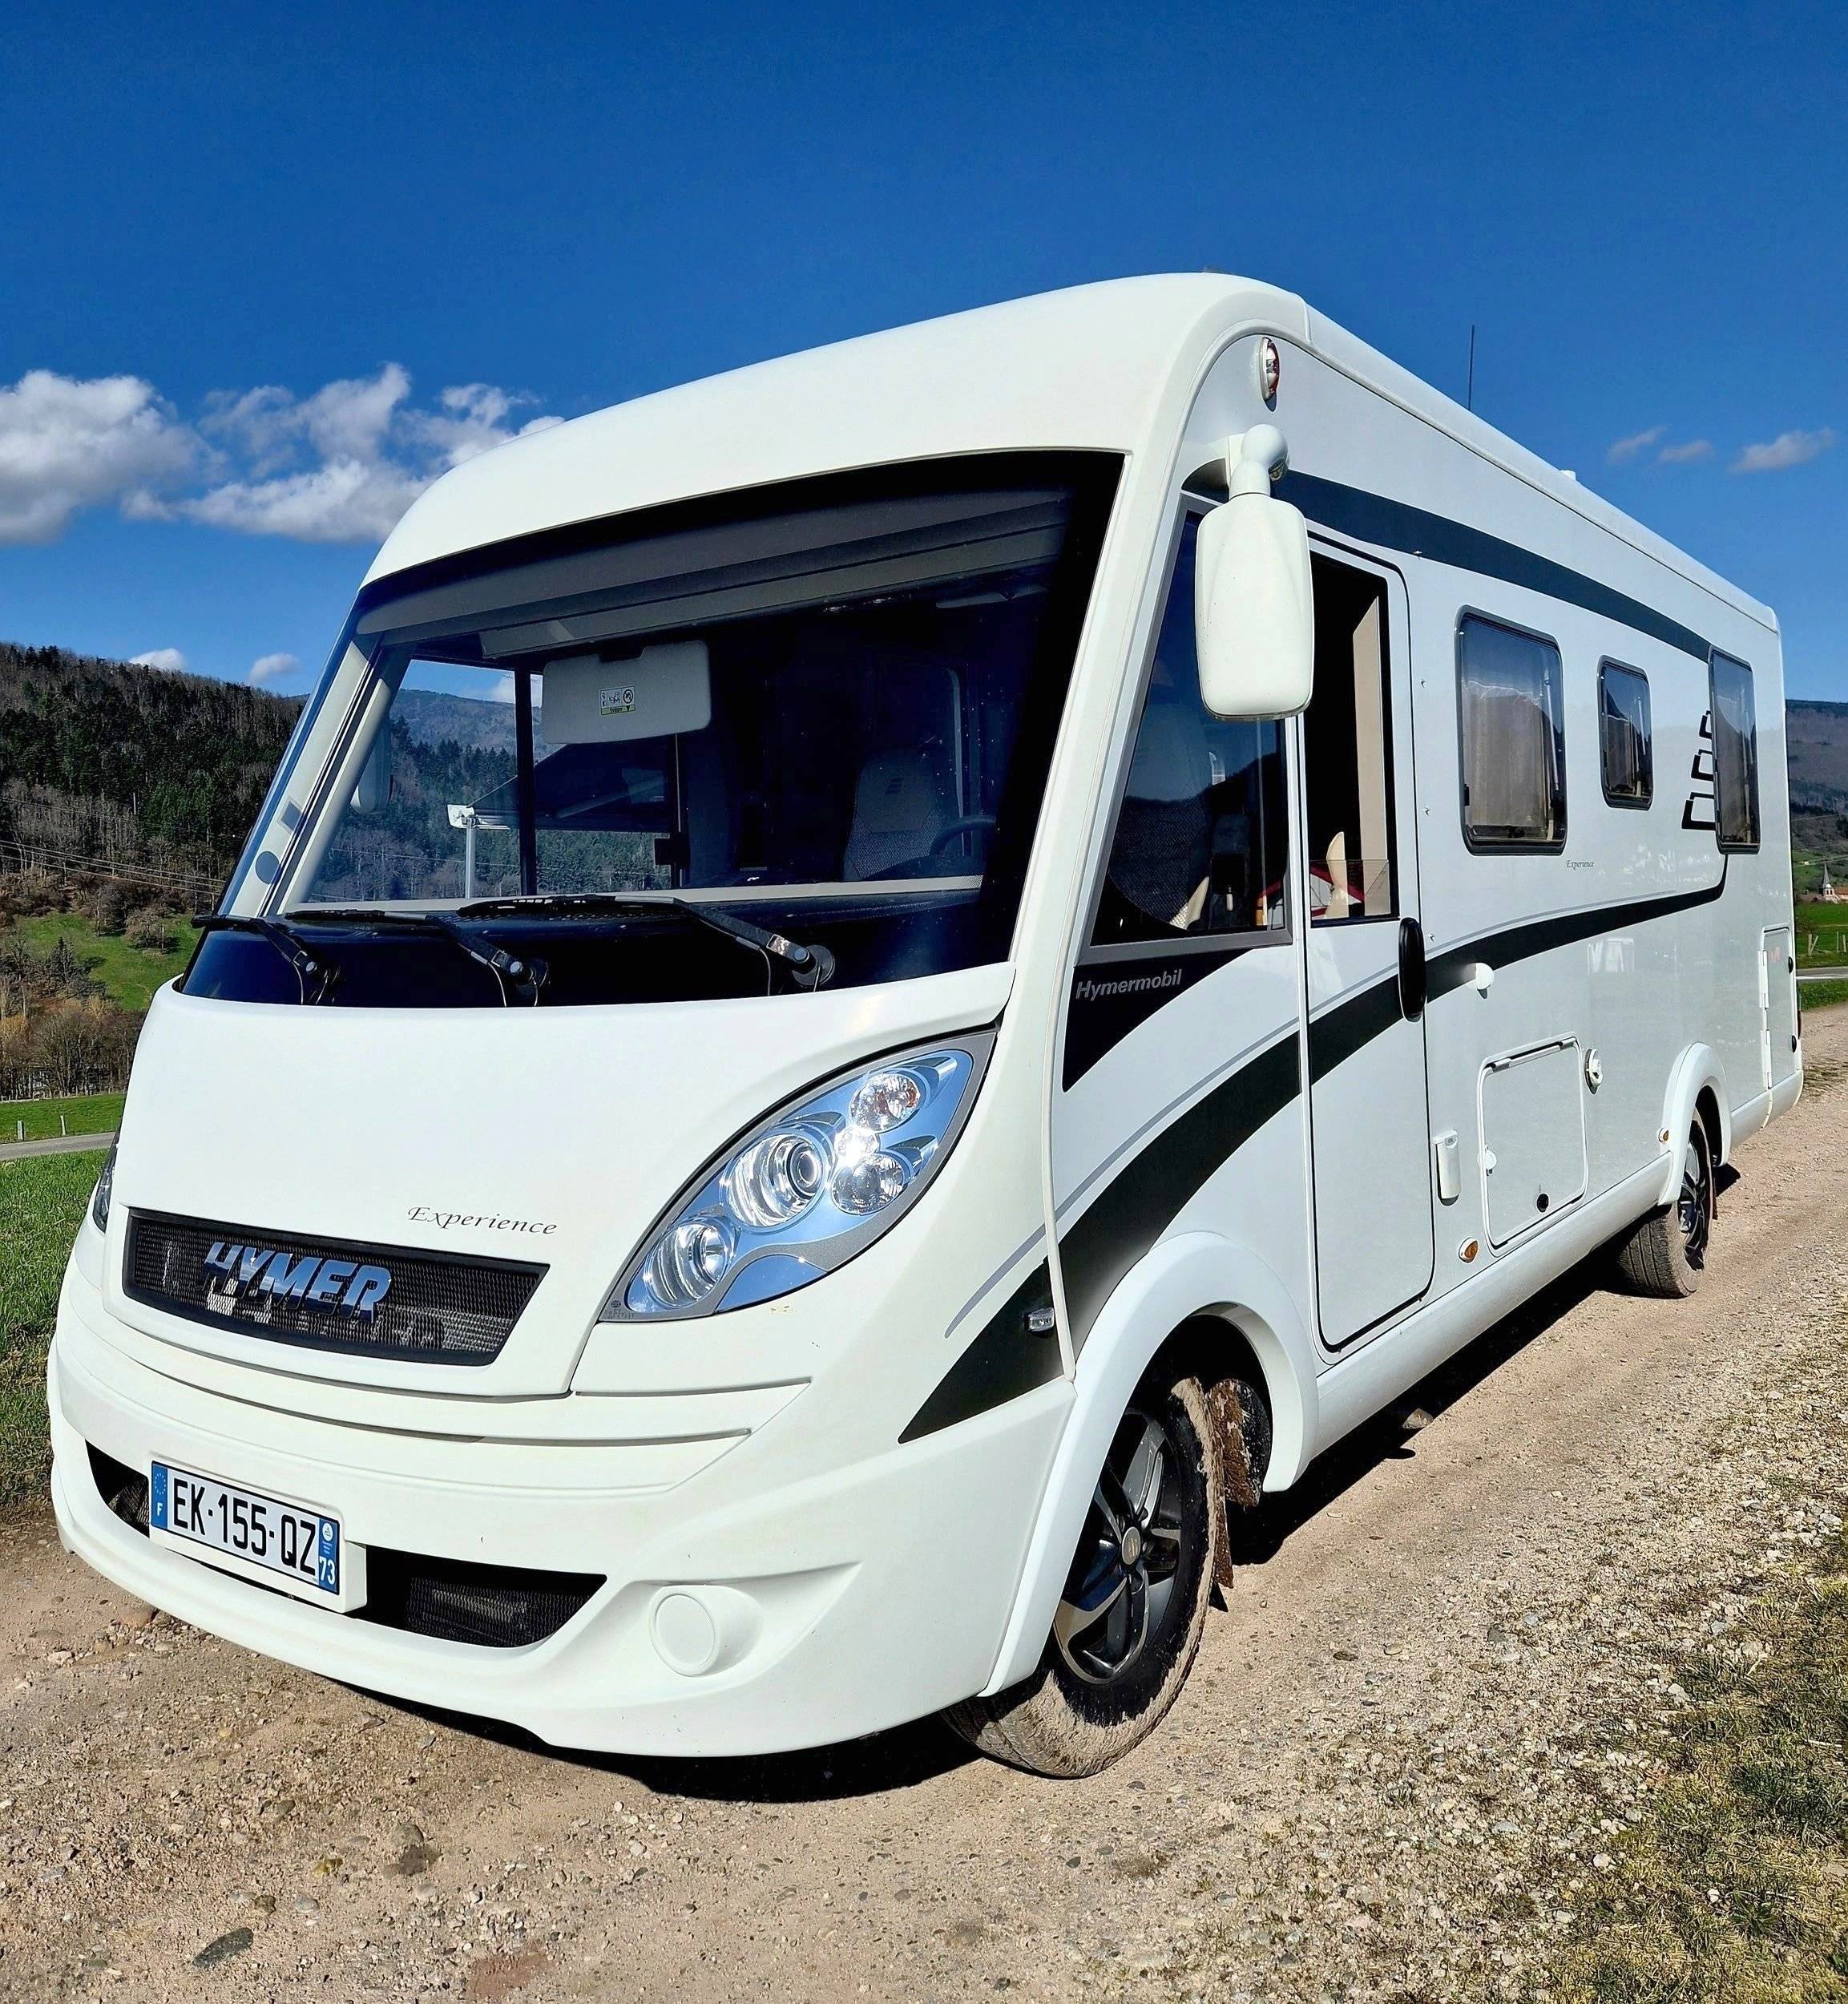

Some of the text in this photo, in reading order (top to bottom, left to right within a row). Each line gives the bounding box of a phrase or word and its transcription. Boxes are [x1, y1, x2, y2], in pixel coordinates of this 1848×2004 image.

[1075, 968, 1182, 1001] Hymermobil
[408, 1206, 558, 1234] Experience
[201, 1242, 392, 1323] HYMER
[156, 1502, 163, 1517] F
[319, 1555, 336, 1585] 73
